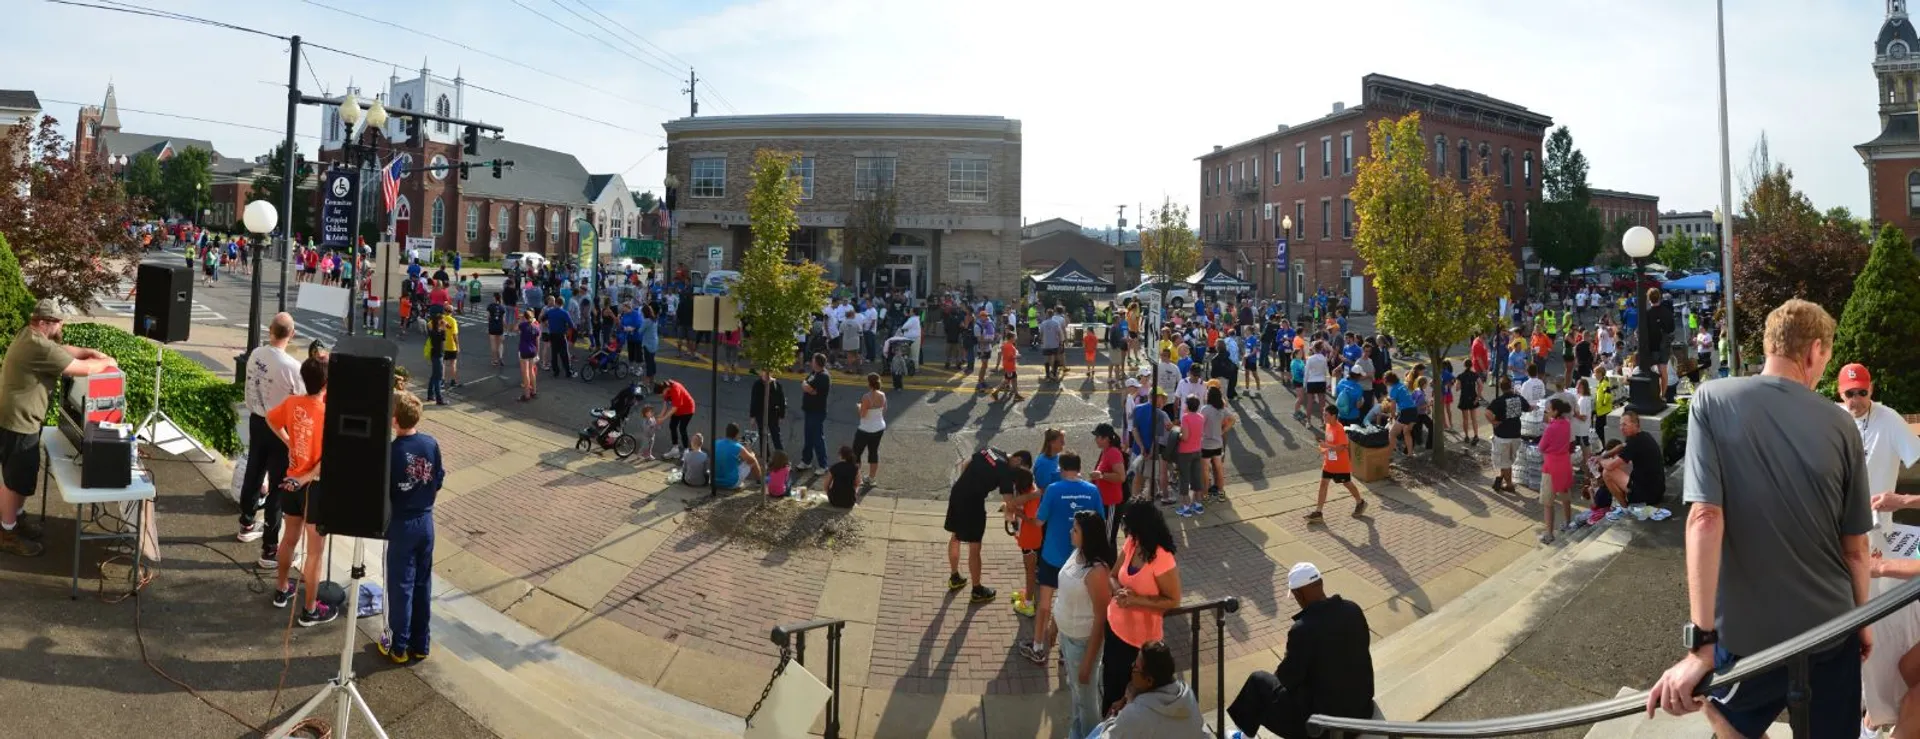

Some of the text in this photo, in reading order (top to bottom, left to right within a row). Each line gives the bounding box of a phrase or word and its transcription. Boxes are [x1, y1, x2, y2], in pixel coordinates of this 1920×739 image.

[334, 207, 342, 215] for
[326, 217, 348, 225] Crippled
[325, 225, 348, 233] Children
